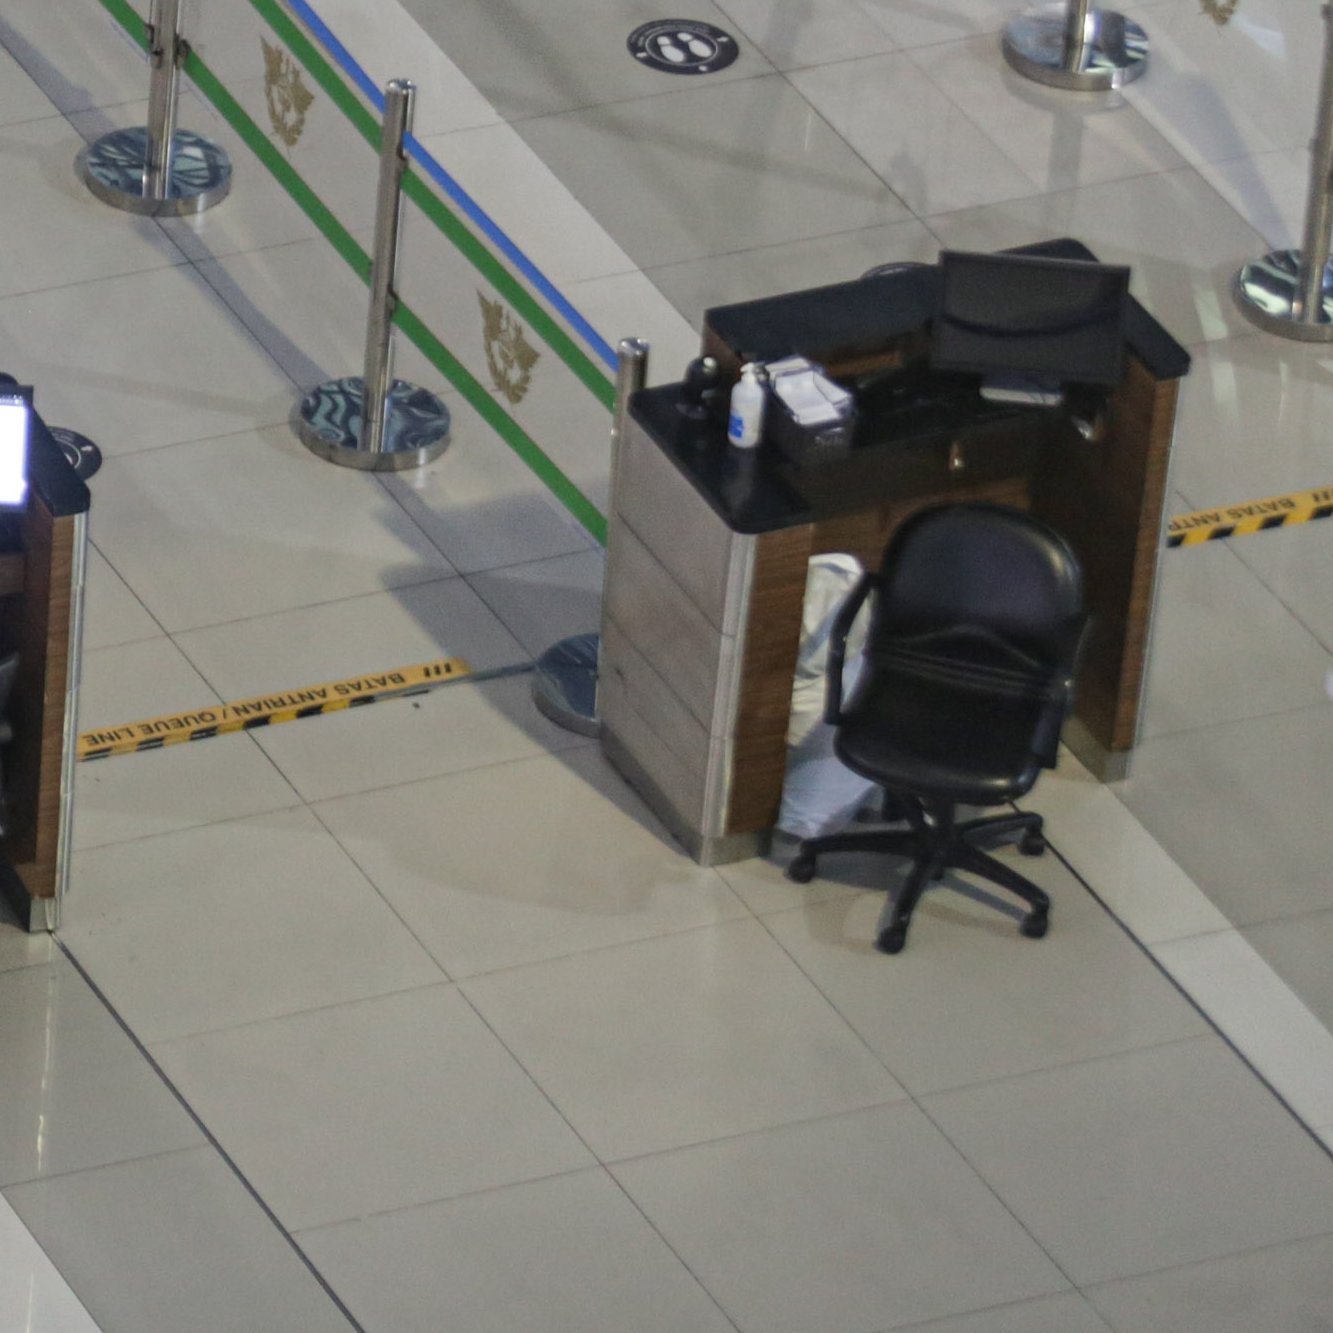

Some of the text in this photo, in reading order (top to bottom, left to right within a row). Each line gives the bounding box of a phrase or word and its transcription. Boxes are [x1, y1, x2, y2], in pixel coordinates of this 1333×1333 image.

[1226, 498, 1295, 519] BATAS
[334, 672, 406, 696] BATAS
[235, 687, 327, 717] ANTRIAN
[86, 725, 135, 746] LINE
[142, 711, 217, 736] QUEUE
